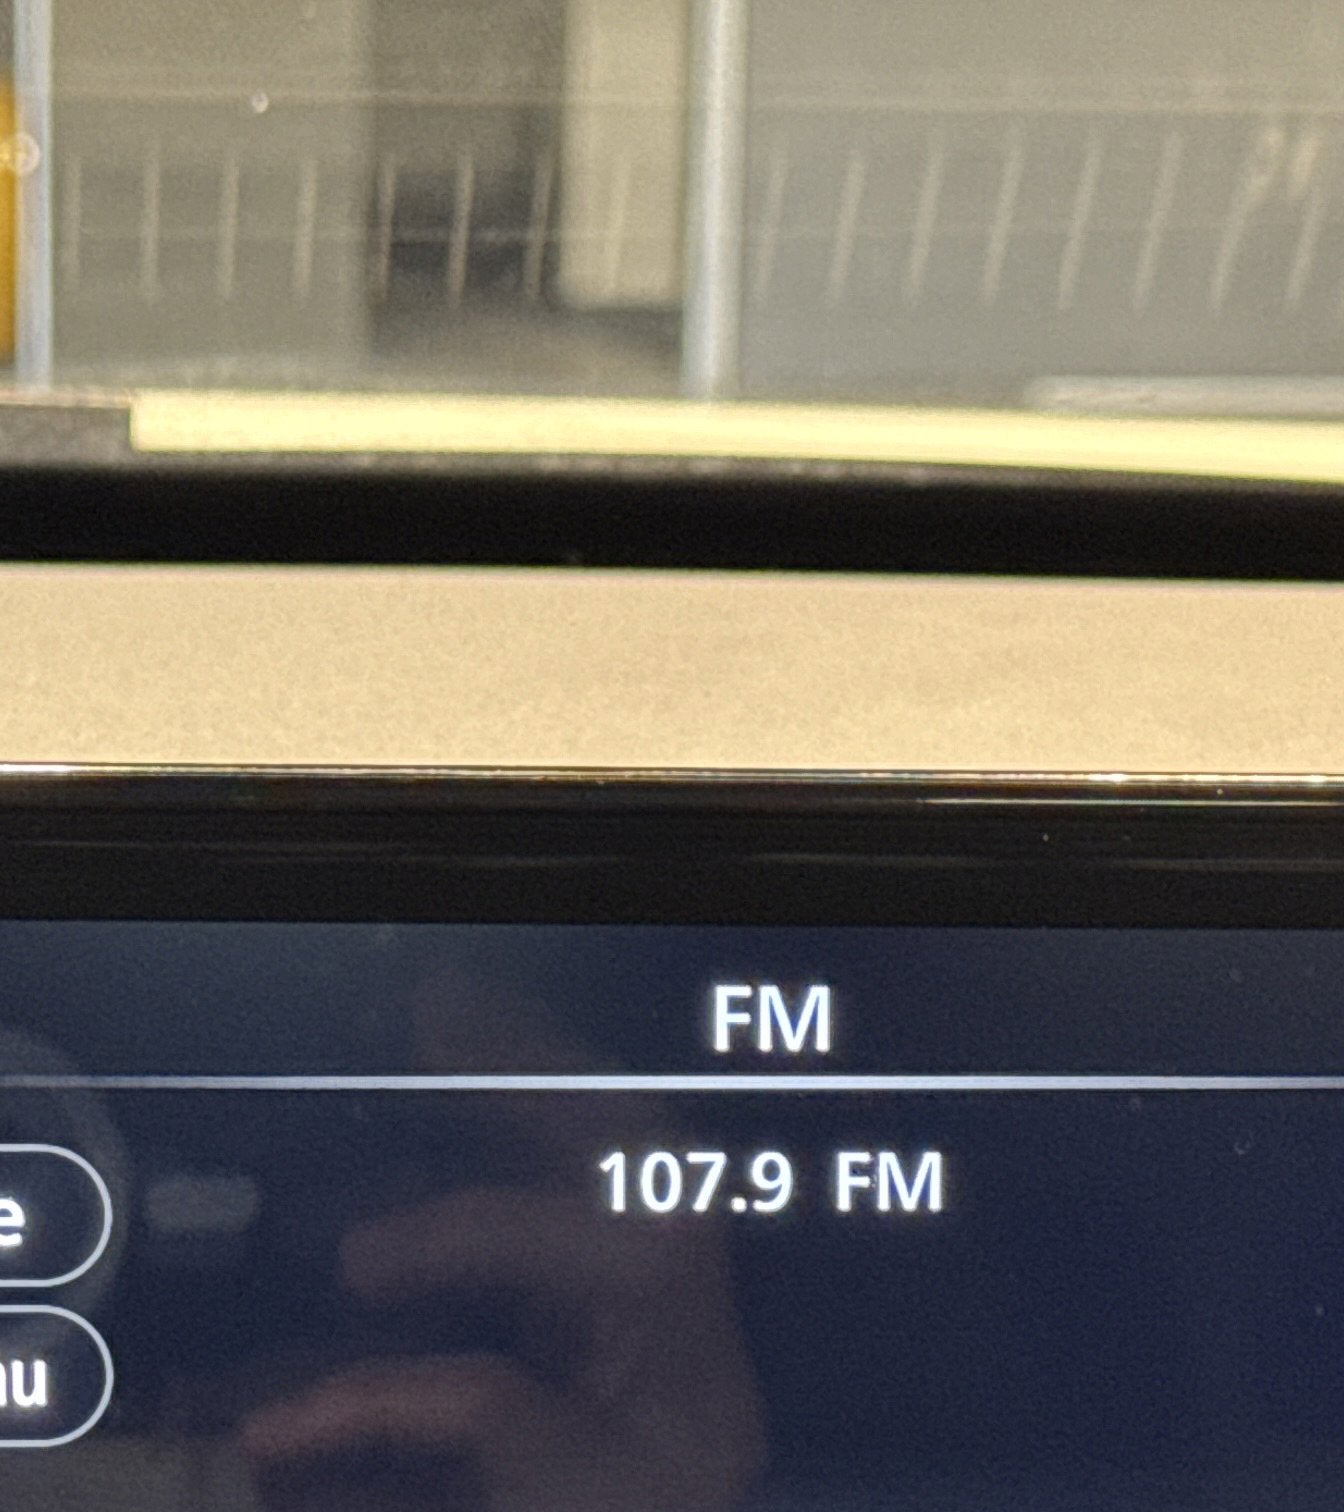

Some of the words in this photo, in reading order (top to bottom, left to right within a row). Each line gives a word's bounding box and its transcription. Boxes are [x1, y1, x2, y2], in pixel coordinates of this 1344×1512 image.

[712, 984, 831, 1052] FM
[599, 1150, 794, 1213] 107.9
[835, 1150, 944, 1212] FM
